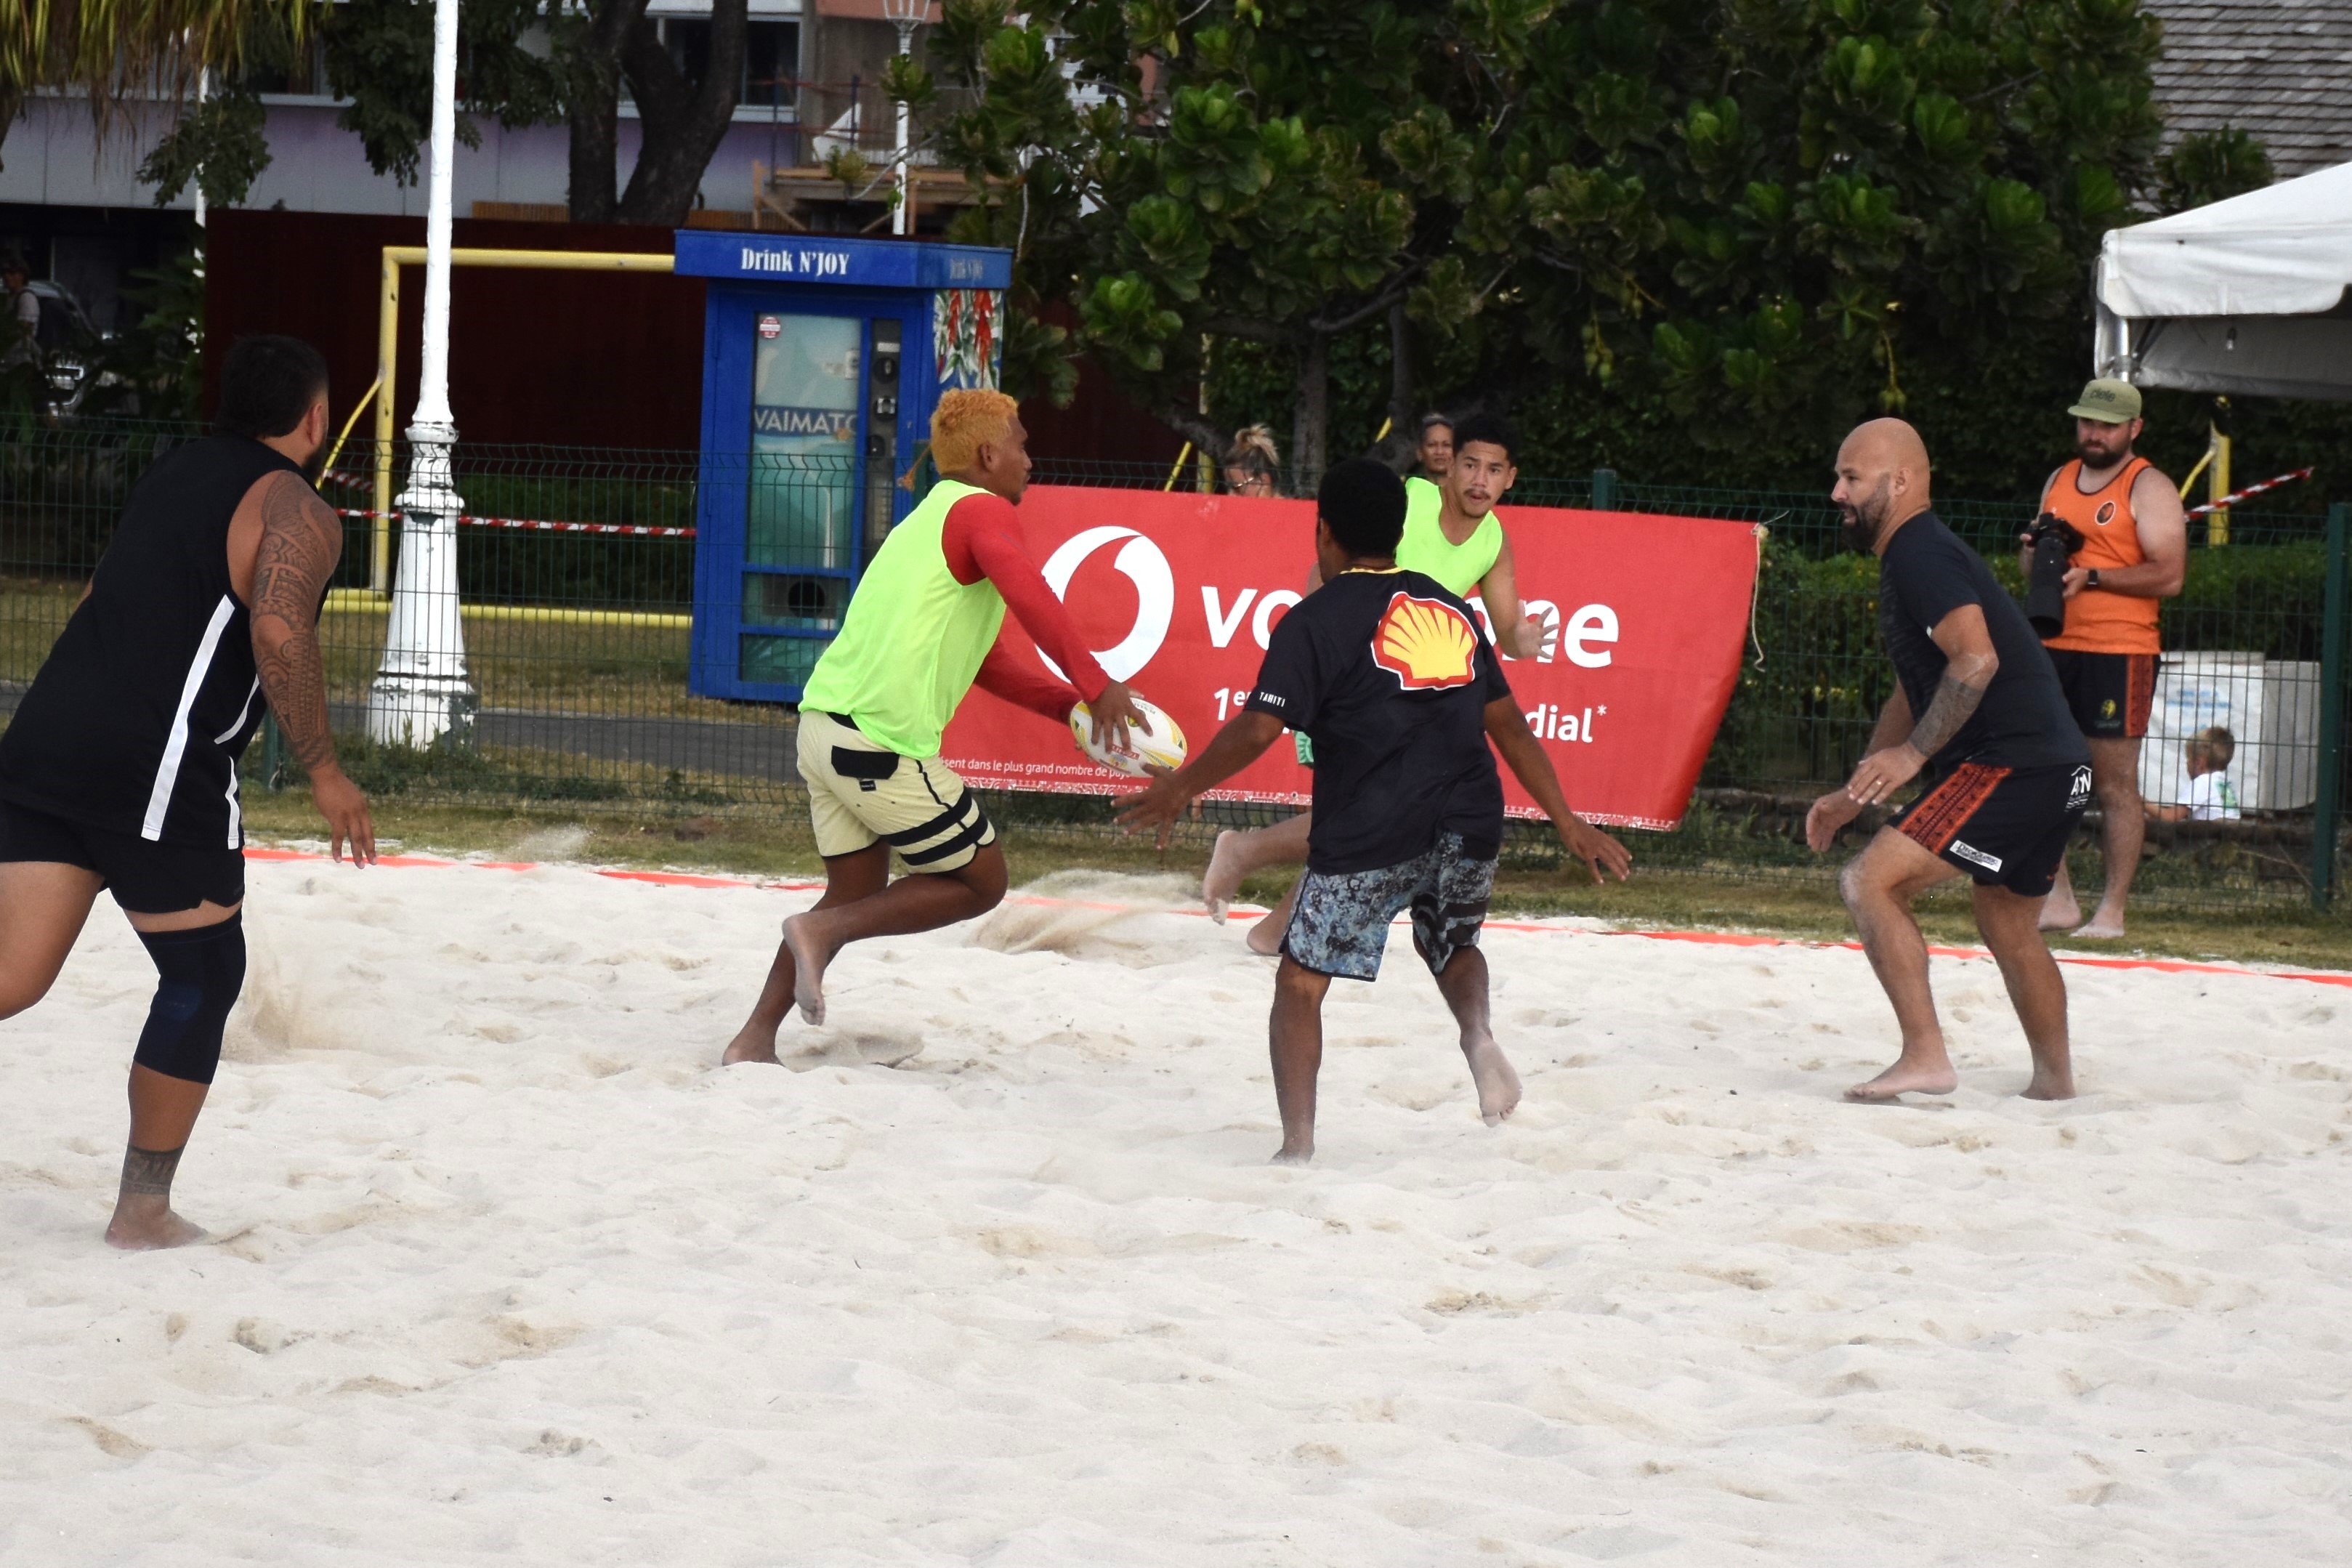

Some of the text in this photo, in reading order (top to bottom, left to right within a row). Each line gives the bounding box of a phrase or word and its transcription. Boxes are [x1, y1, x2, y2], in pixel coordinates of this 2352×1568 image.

[741, 248, 793, 272] Drink
[1201, 586, 1620, 668] vone
[1258, 691, 1286, 708] TAHITI
[967, 759, 991, 770] dans
[993, 759, 1002, 771] le
[1003, 761, 1024, 774] plus
[1025, 763, 1054, 775] grand
[1055, 764, 1094, 776] nombre
[1095, 767, 1107, 777] de
[1109, 769, 1131, 780] pay
